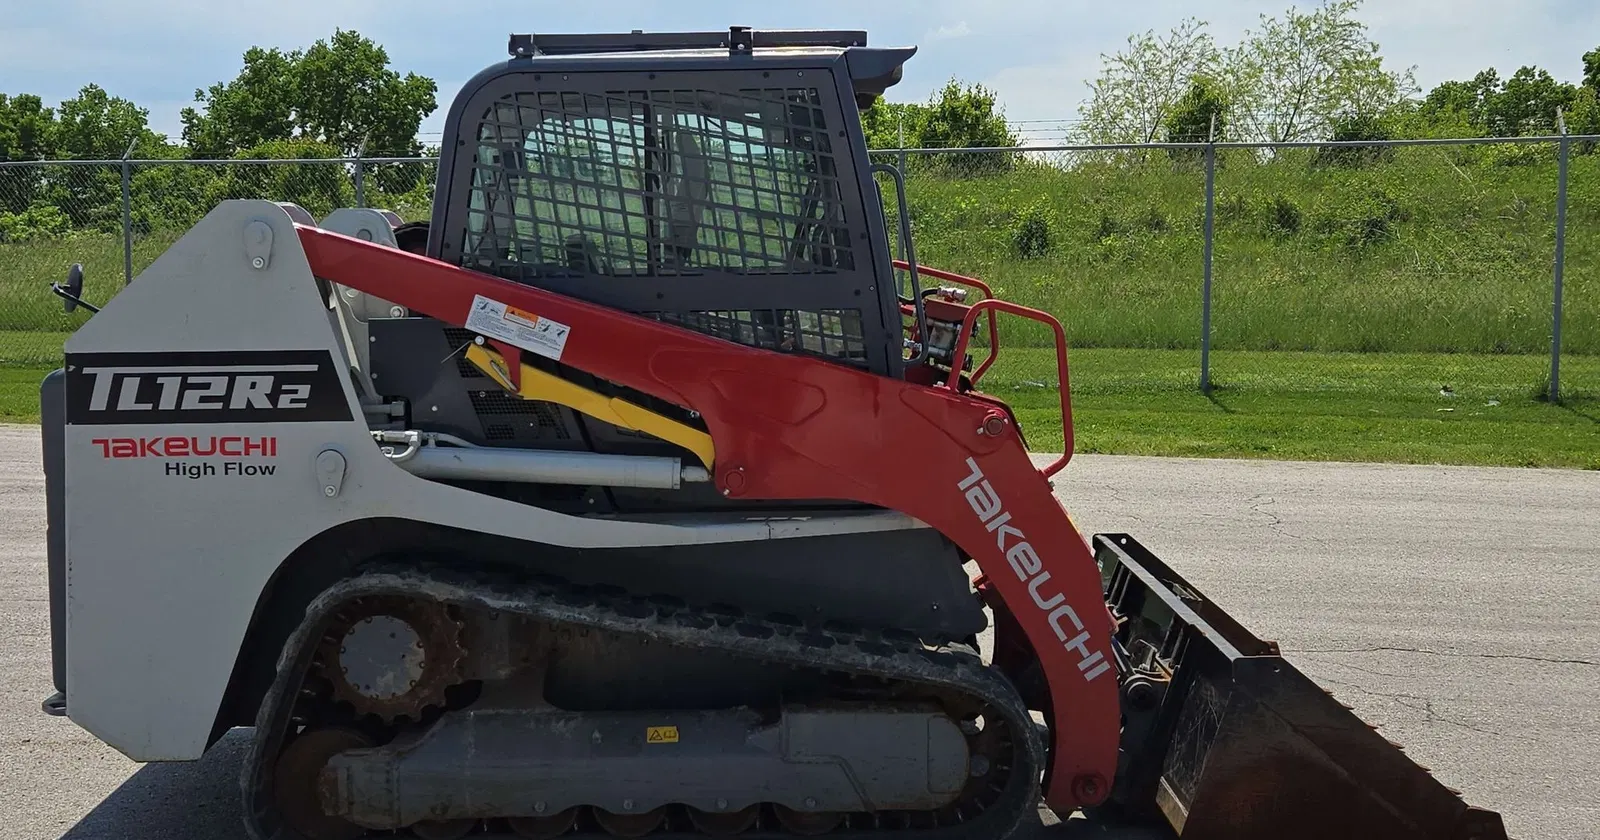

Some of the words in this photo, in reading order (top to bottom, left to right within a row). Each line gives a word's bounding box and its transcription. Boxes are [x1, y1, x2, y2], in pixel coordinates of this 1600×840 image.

[83, 364, 319, 411] TL12R2
[164, 461, 216, 480] High
[223, 461, 277, 476] Flow
